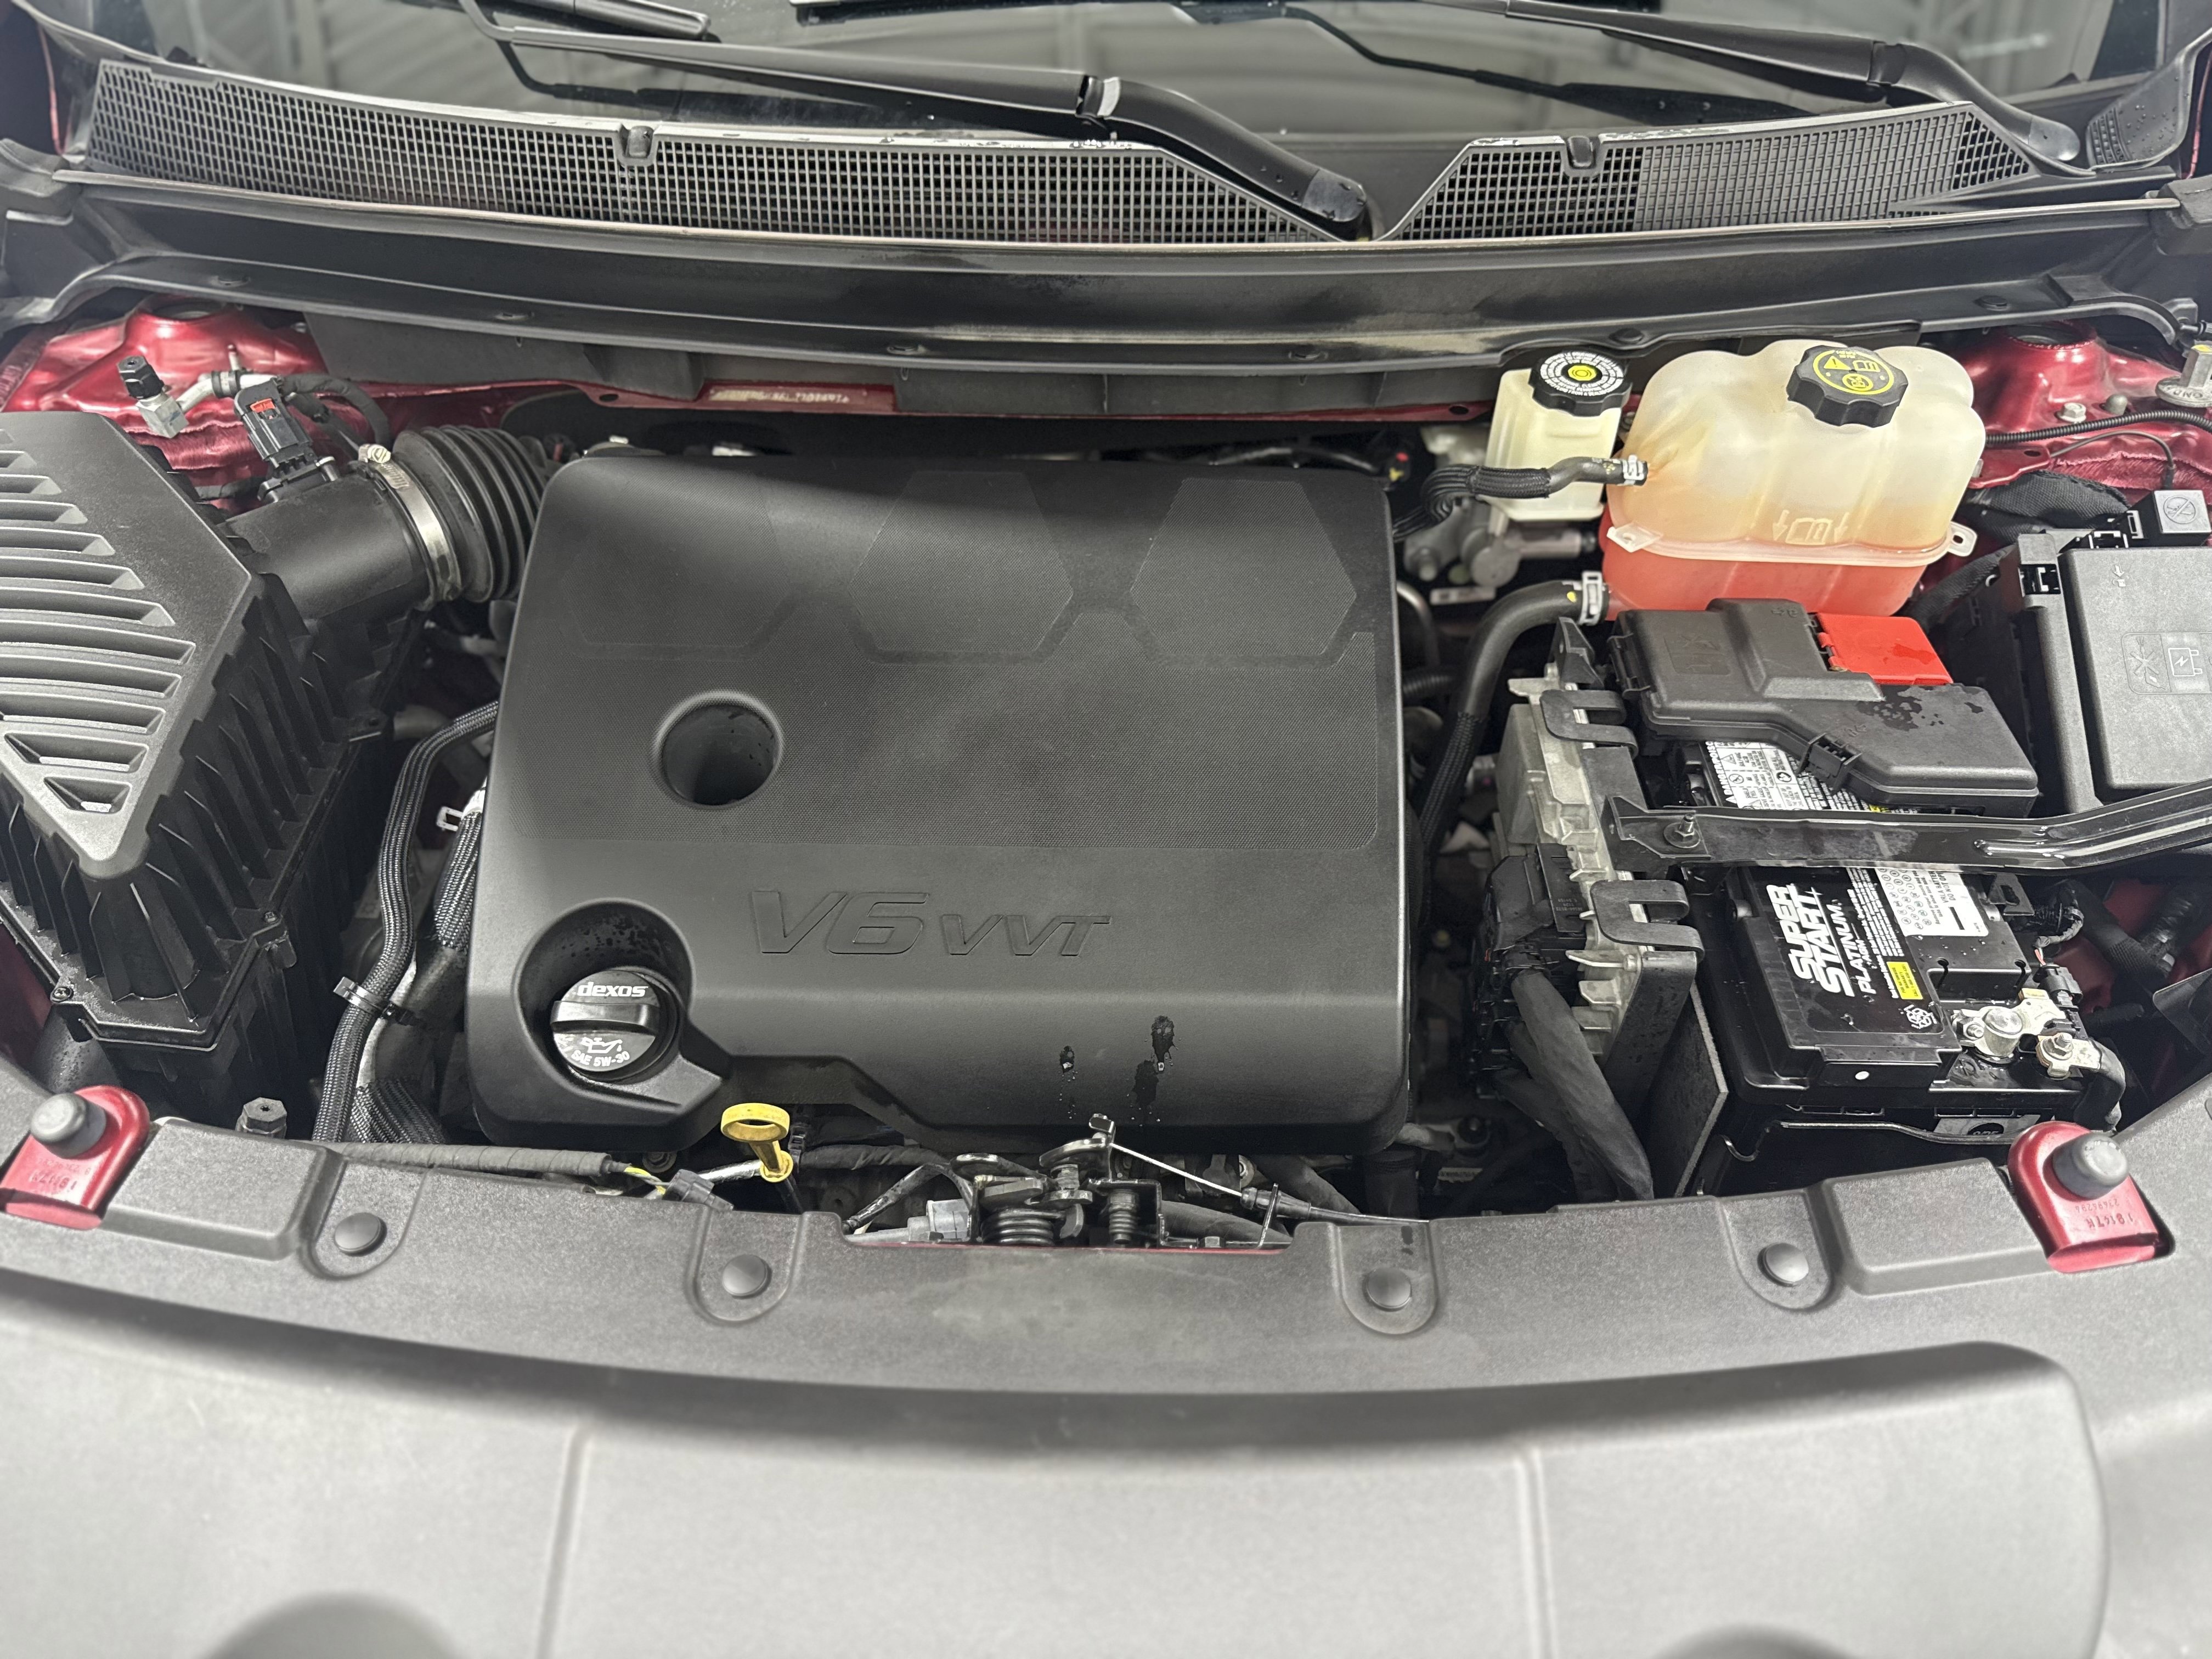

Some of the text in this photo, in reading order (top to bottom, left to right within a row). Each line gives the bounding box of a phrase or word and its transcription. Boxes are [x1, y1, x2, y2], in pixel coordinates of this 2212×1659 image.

[1705, 741, 1734, 795] DANGER/POISO
[1929, 871, 1942, 888] BATTER
[1942, 882, 1951, 891] NOT
[751, 890, 1113, 956] V6 VVT
[1766, 884, 1819, 980] SUPER
[1786, 884, 1855, 997] START
[1826, 904, 1876, 994] PLATINUM
[1855, 939, 1872, 963] AGM
[577, 981, 648, 997] dexos
[571, 1049, 630, 1067] SAE 5W-30
